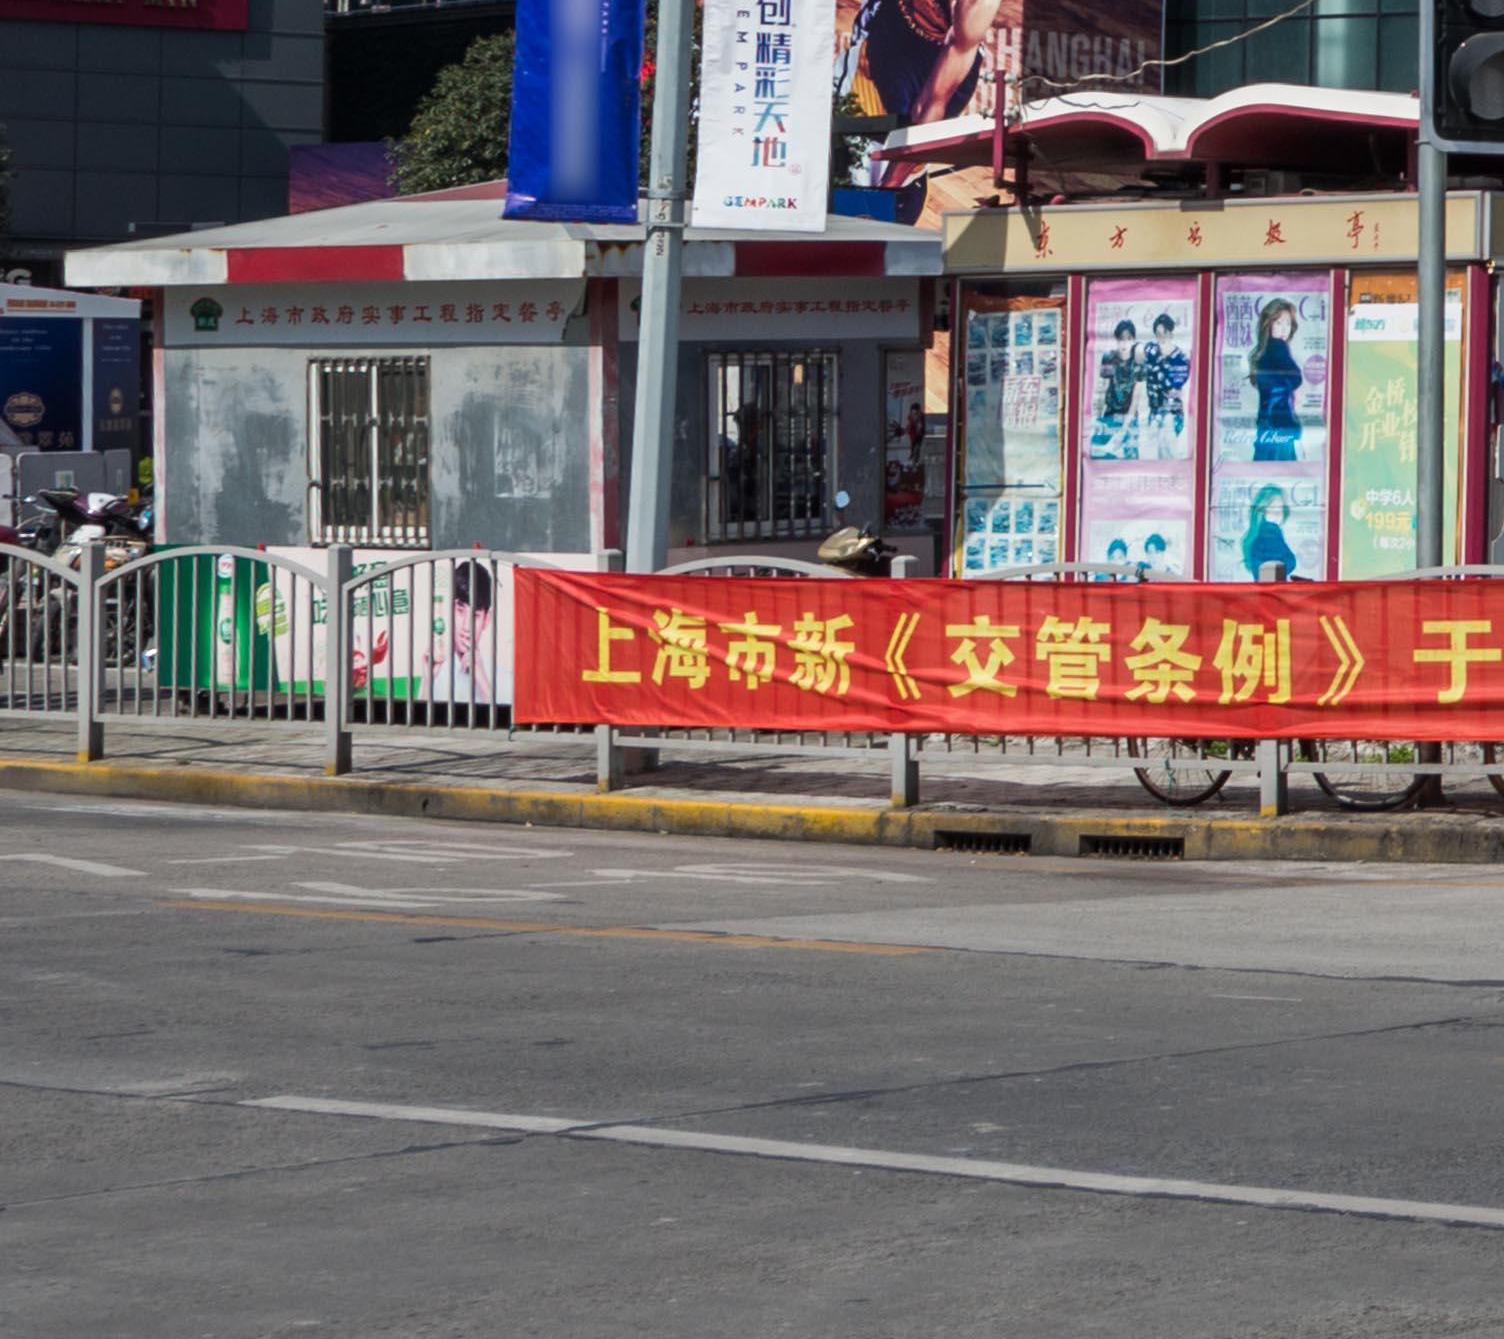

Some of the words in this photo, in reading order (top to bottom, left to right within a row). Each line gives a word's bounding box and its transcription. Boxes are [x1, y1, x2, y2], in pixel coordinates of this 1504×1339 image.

[982, 27, 1147, 86] SHANGHAI
[722, 194, 798, 211] GEMPARK
[235, 300, 565, 326] 上海市政府实事工程指定餐亭
